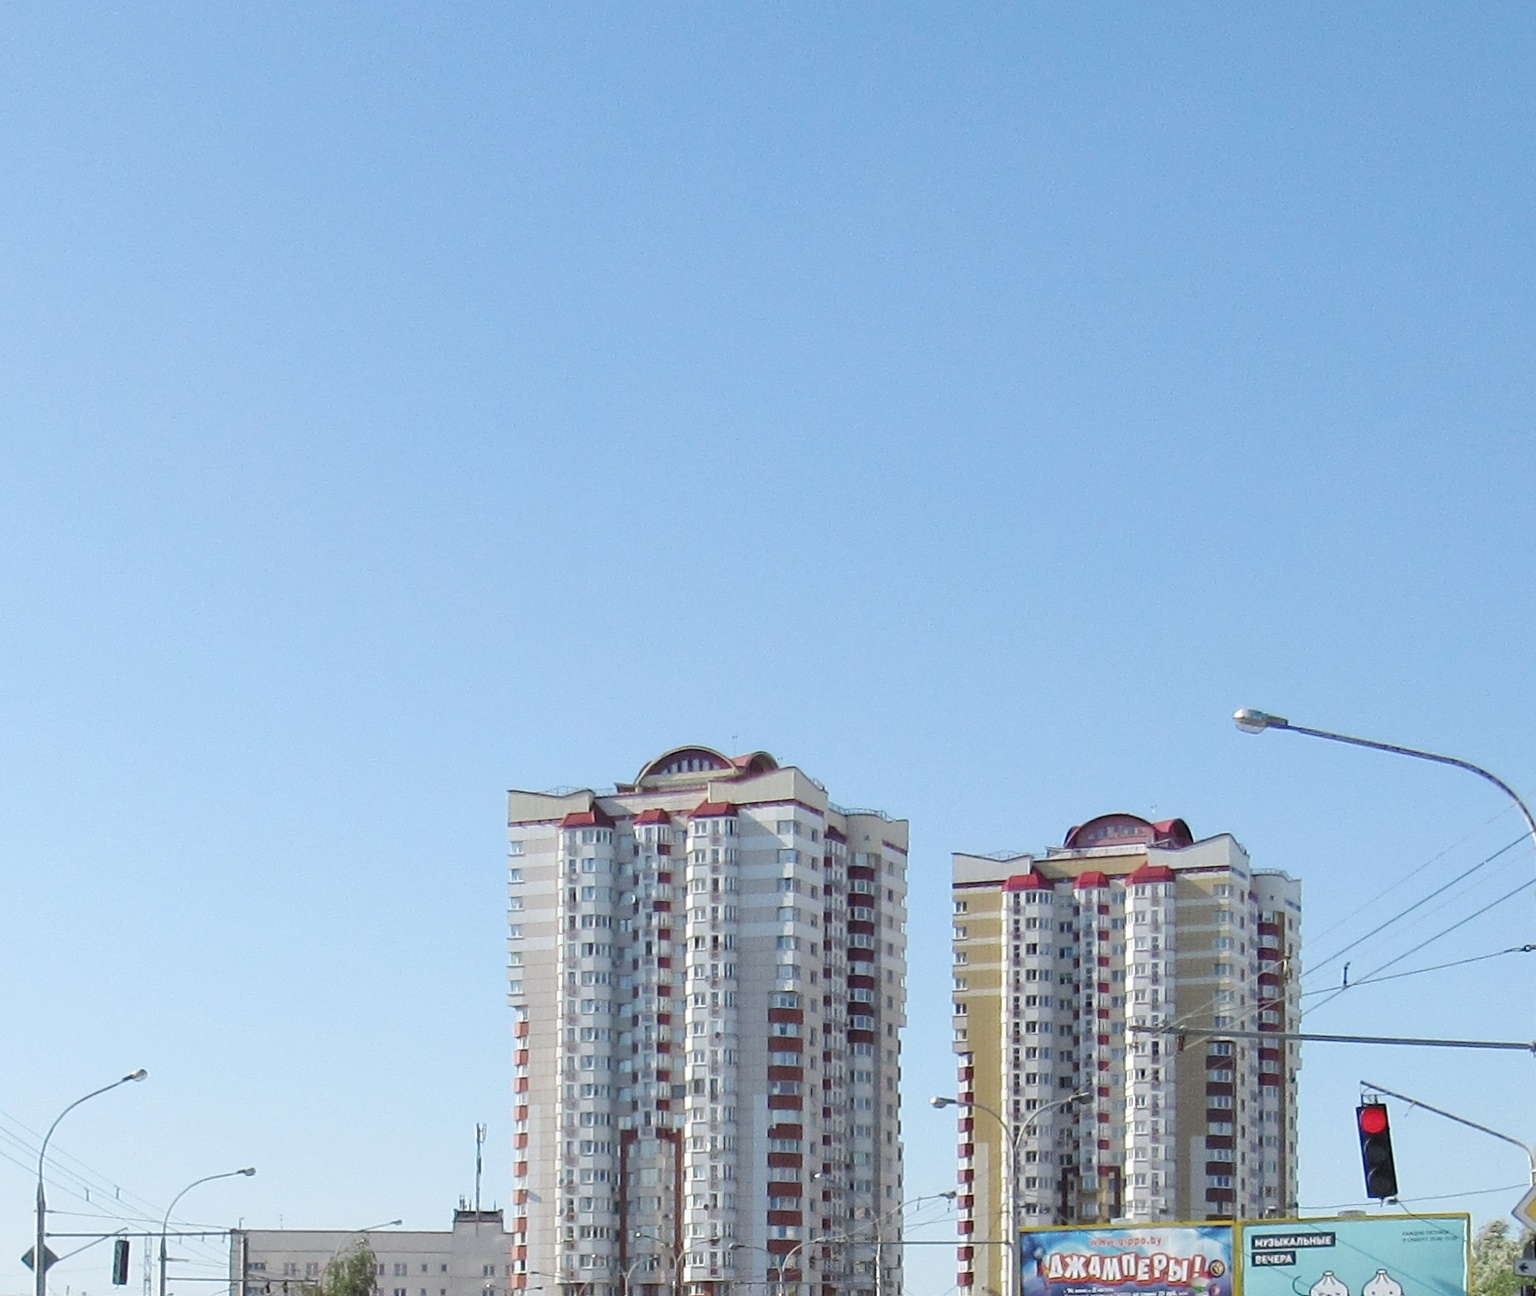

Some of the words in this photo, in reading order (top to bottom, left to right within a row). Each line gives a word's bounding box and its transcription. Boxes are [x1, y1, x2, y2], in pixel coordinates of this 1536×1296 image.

[1254, 1234, 1333, 1248] МУЗЫКАЛЬНЫЕ
[1254, 1254, 1293, 1265] ВЕЧЕРА
[1048, 1252, 1204, 1284] ДЖАМПЕРЫ!
